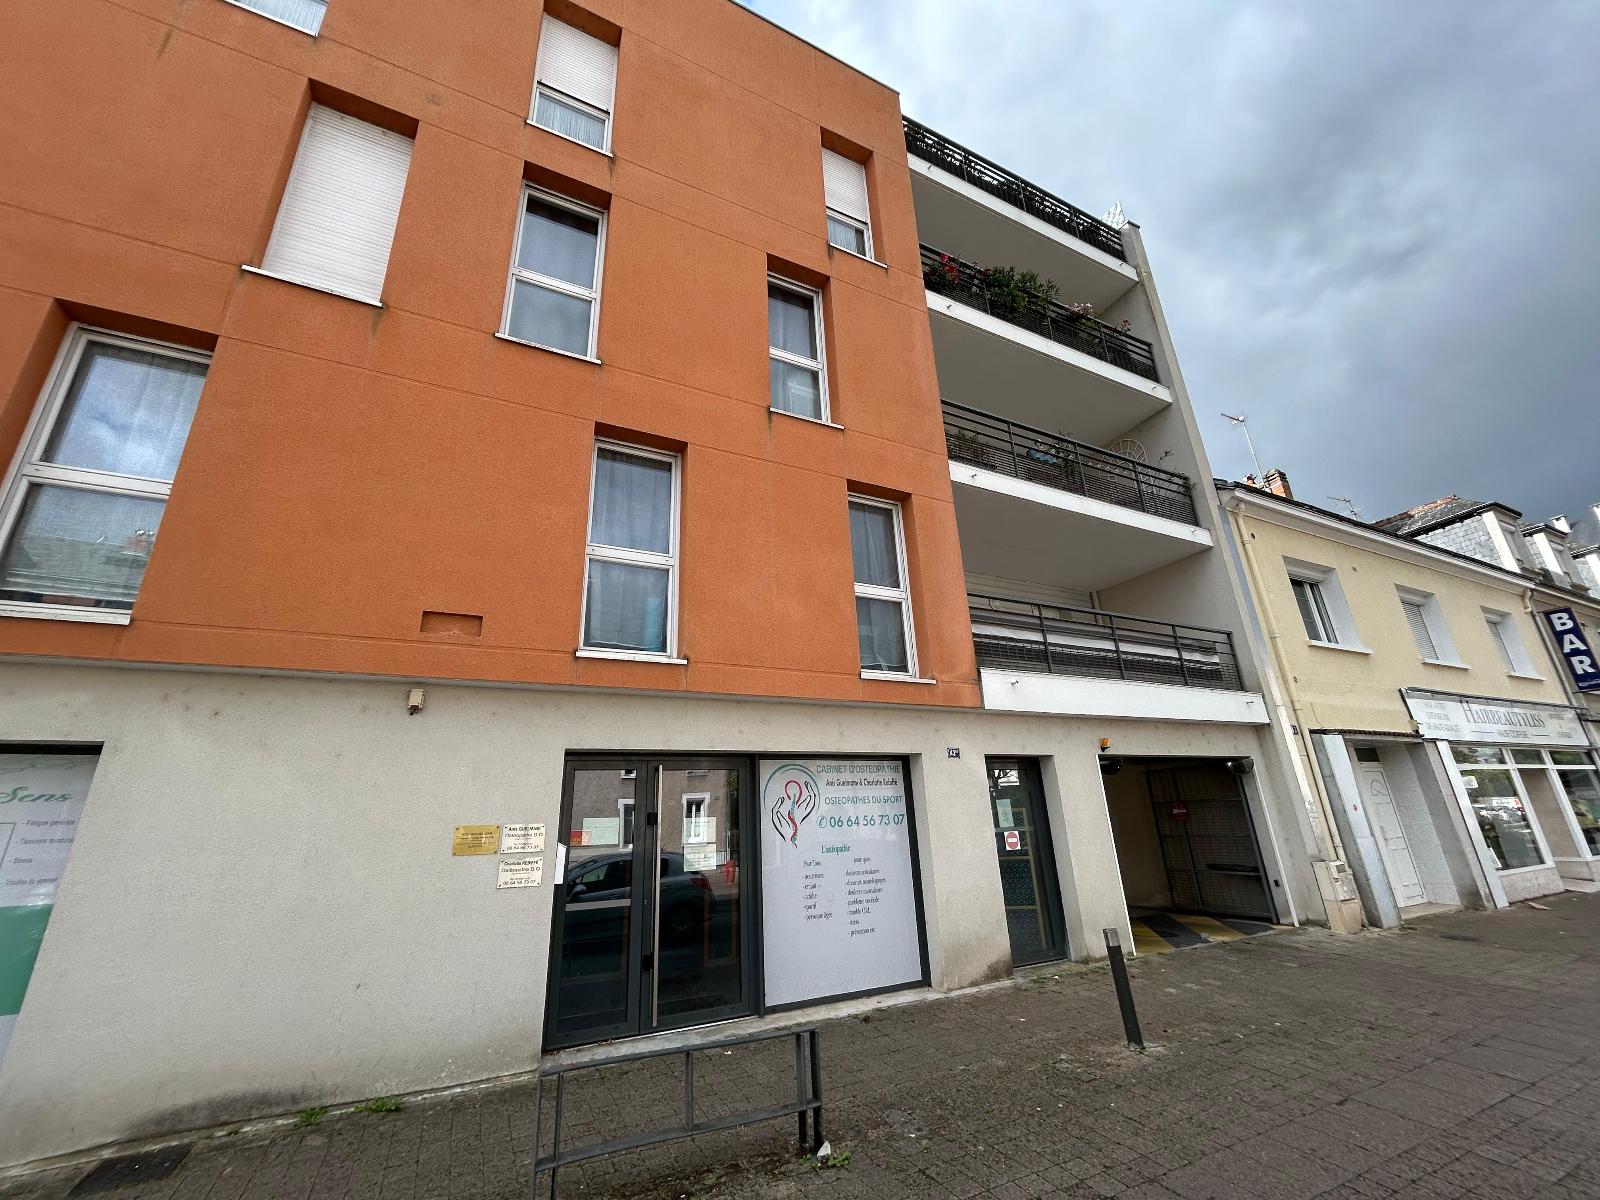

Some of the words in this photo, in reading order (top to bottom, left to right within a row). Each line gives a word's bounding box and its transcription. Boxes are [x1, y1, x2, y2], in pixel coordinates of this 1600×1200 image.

[1549, 612, 1597, 675] BAR
[816, 764, 847, 774] CABINET
[824, 796, 871, 806] OSTEOPATHES
[872, 796, 883, 805] DU
[883, 795, 903, 804] SPORT
[829, 816, 844, 828] 06
[846, 816, 860, 828] 64
[863, 815, 876, 827] 56
[878, 814, 891, 826] 73
[893, 813, 905, 825] 07
